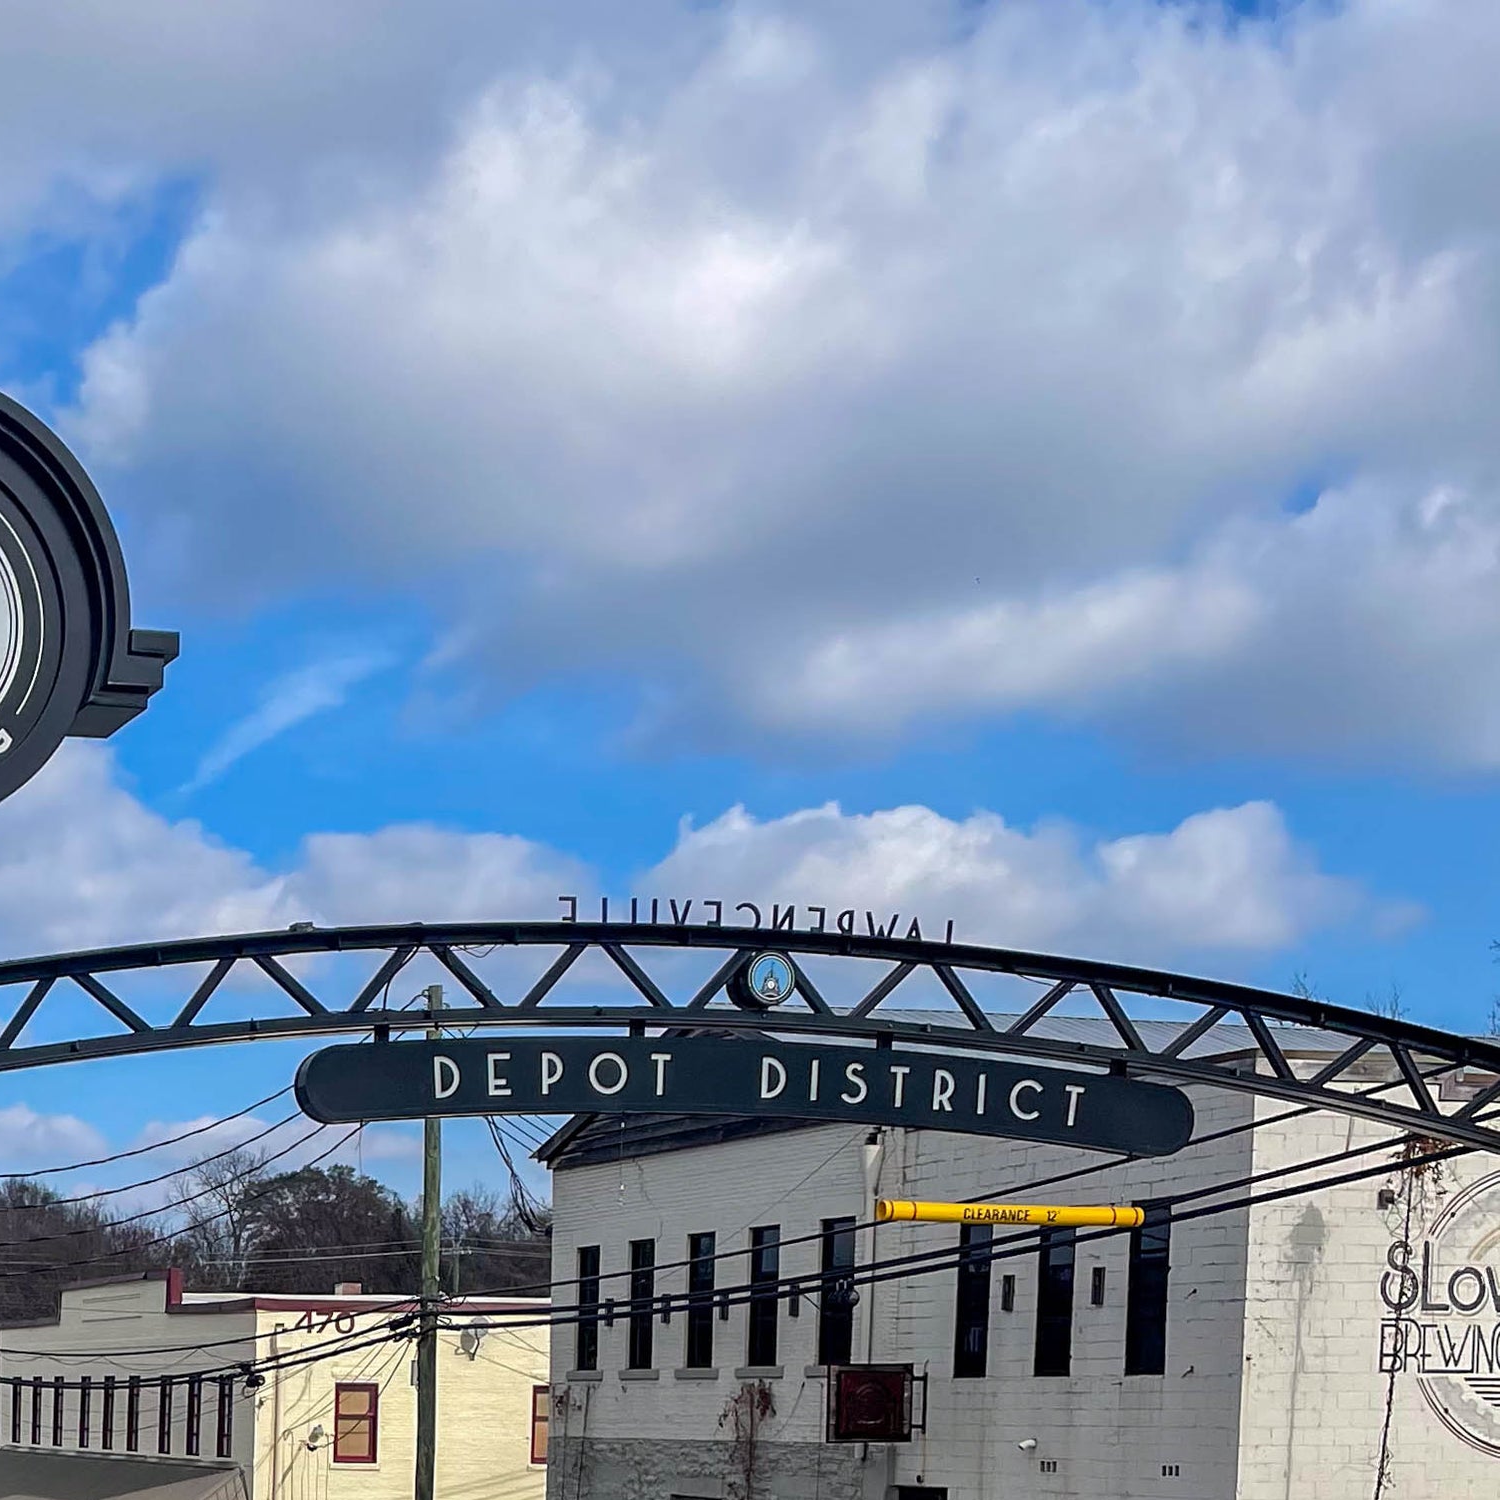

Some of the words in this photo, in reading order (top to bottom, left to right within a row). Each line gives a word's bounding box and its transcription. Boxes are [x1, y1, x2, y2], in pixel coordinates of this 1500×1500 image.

[433, 1052, 672, 1099] DEPOT
[760, 1056, 1086, 1126] DISTRICT
[963, 1207, 1031, 1222] CLEARANCE
[294, 1308, 355, 1334] 470
